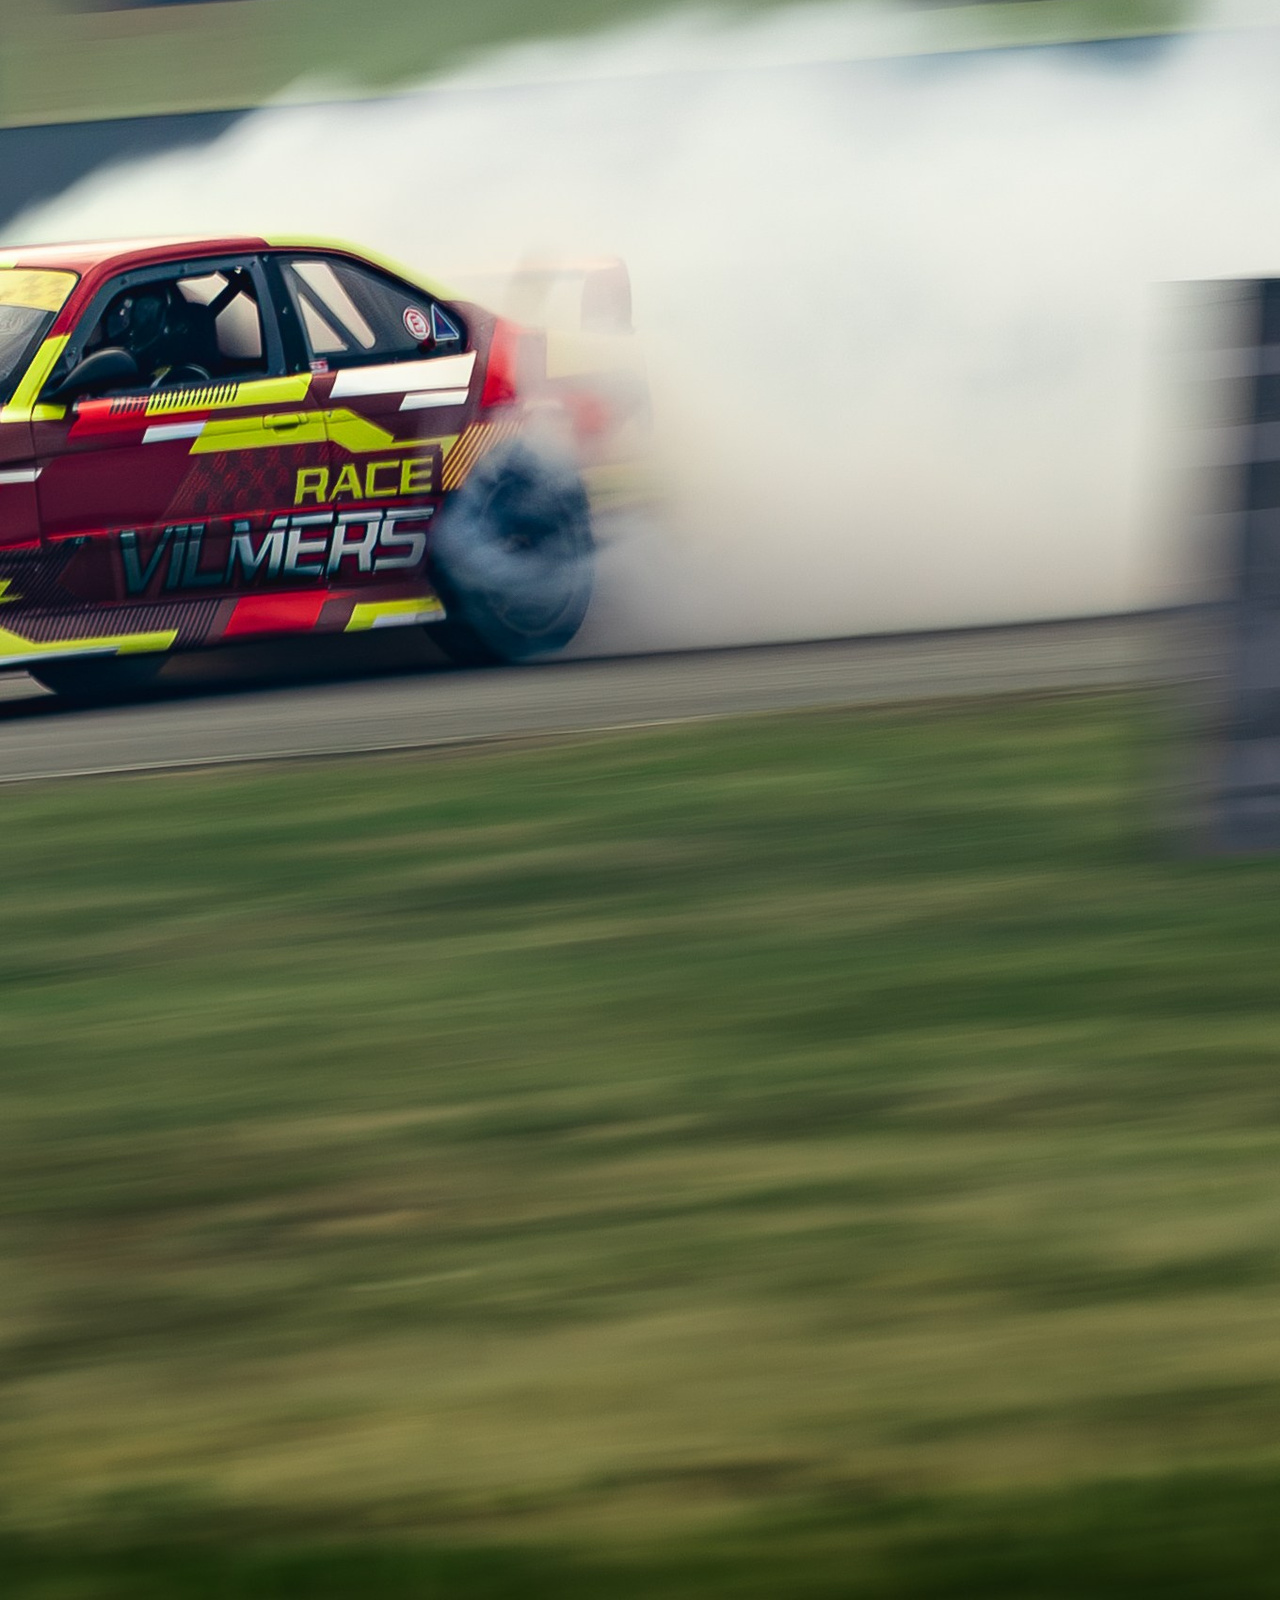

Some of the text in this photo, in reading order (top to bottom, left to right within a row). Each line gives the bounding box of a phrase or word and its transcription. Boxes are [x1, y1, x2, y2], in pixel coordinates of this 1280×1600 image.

[410, 315, 425, 333] E
[293, 456, 435, 505] RACE
[120, 505, 435, 595] VILMERS
